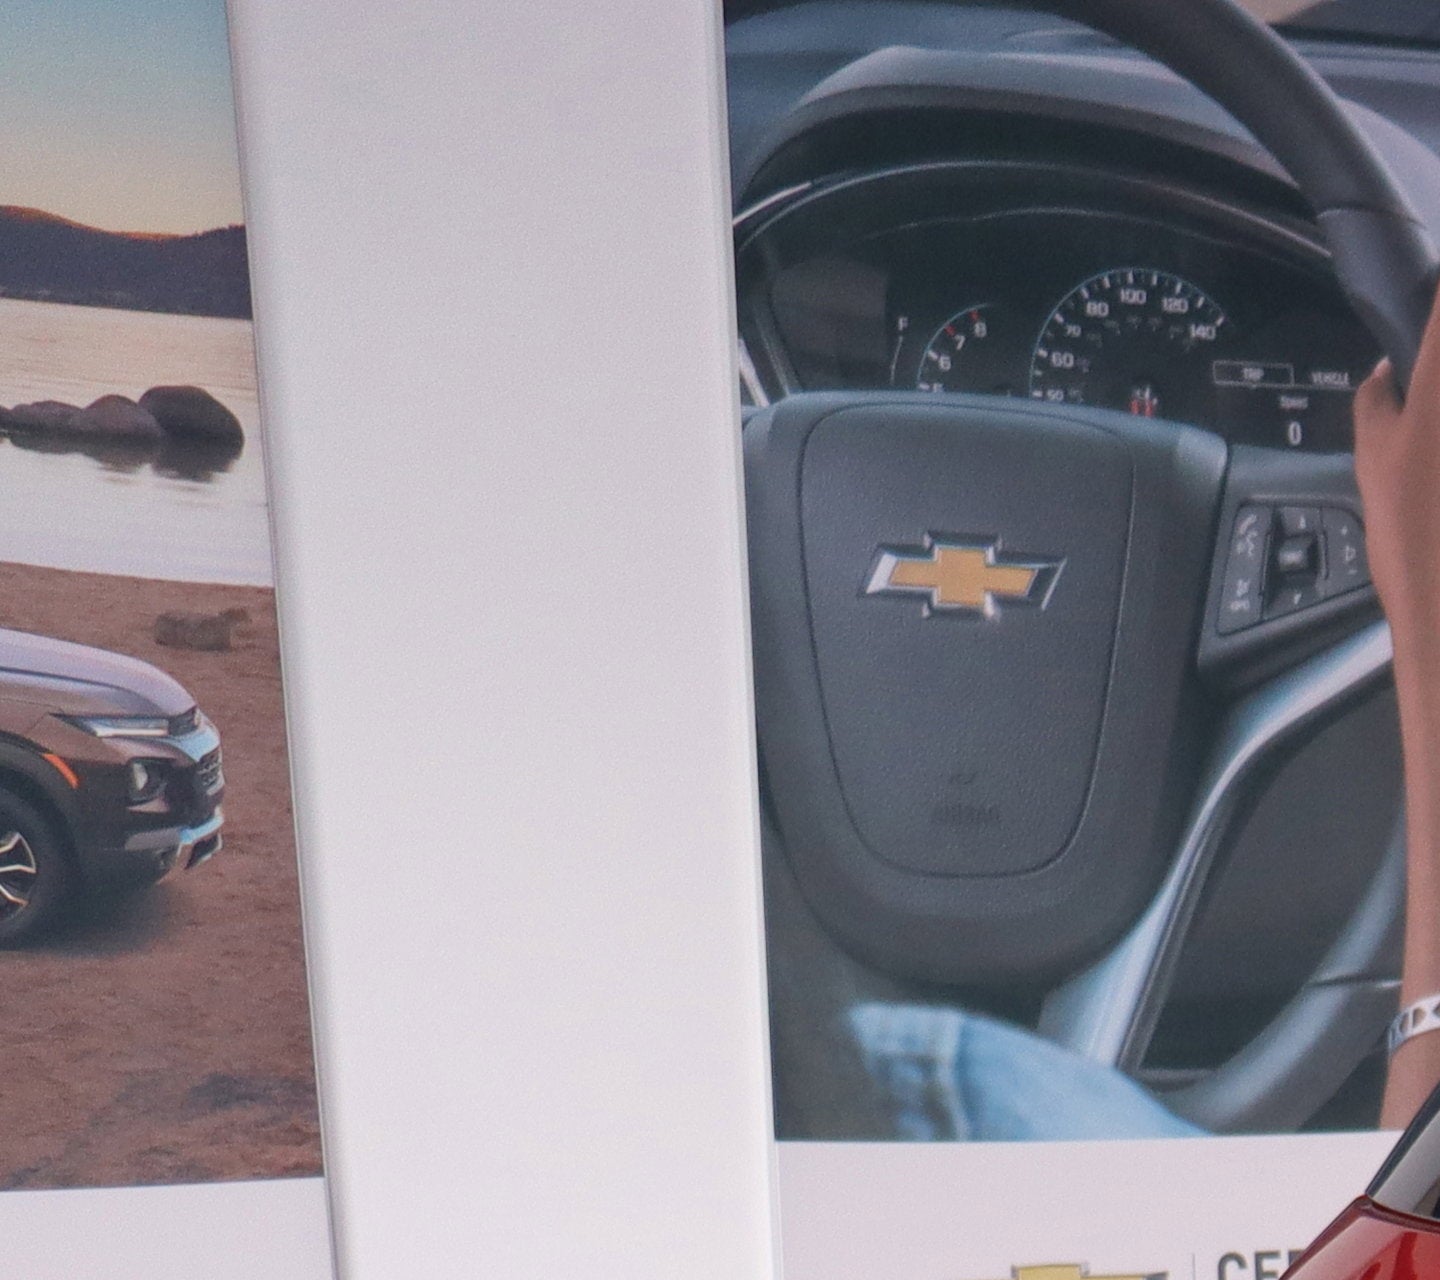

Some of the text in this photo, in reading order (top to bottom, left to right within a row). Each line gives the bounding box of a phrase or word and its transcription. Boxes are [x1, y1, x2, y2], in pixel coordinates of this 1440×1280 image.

[1119, 288, 1148, 305] 100
[939, 355, 951, 371] 6
[1051, 352, 1075, 369] 60
